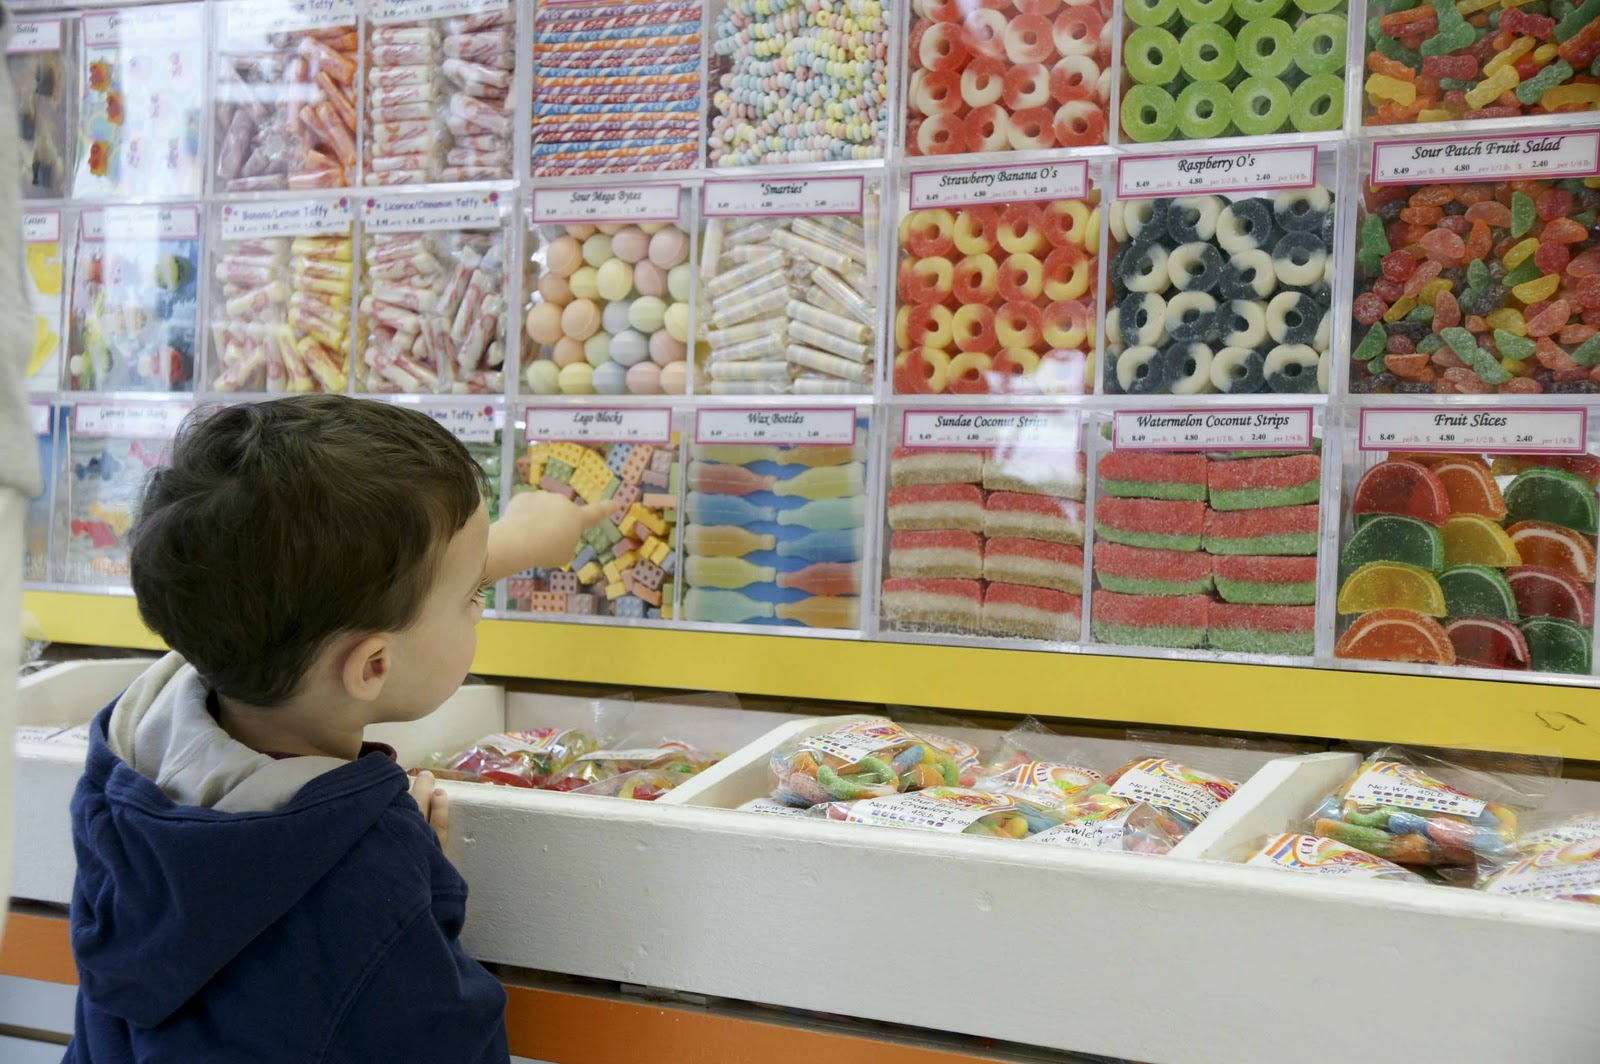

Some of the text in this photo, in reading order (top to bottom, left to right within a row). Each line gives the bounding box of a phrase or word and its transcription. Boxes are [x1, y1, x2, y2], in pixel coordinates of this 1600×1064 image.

[1411, 136, 1566, 160] Sour Patch Fruit Salad
[1177, 153, 1256, 173] Raspberry O's
[1393, 167, 1410, 175] 8.49
[1453, 163, 1470, 172] 4.80
[1531, 160, 1549, 168] 2.40
[939, 166, 1058, 187] Strawberry Banana O's
[1135, 180, 1150, 188] 8.49
[1188, 177, 1203, 185] 4.80
[1255, 172, 1271, 181] 2.40
[760, 181, 809, 196] "Smarties"
[926, 193, 939, 201] 8.49
[974, 190, 987, 198] 4.80
[1034, 186, 1048, 194] 2.40
[456, 198, 479, 209] Taffy
[569, 190, 643, 205] Sour Mega Bytes
[243, 205, 329, 221] Banana/Lemon Taffy
[451, 409, 475, 421] Taffy
[573, 410, 624, 426] Lego Blocks
[747, 412, 805, 426] Wax Bottles
[934, 414, 1048, 429] Sundae Coconut Strips
[1136, 413, 1290, 430] Watermelon Coconut Strips
[1433, 413, 1508, 428] Fruit Slices
[1131, 434, 1146, 442] 8.49
[1251, 433, 1267, 441] 2.40
[1439, 434, 1455, 442] 4.80
[1515, 434, 1533, 442] 2.40
[1129, 782, 1148, 790] Net
[1367, 783, 1388, 791] Net
[869, 801, 888, 809] Net
[900, 800, 954, 815] Crawlers
